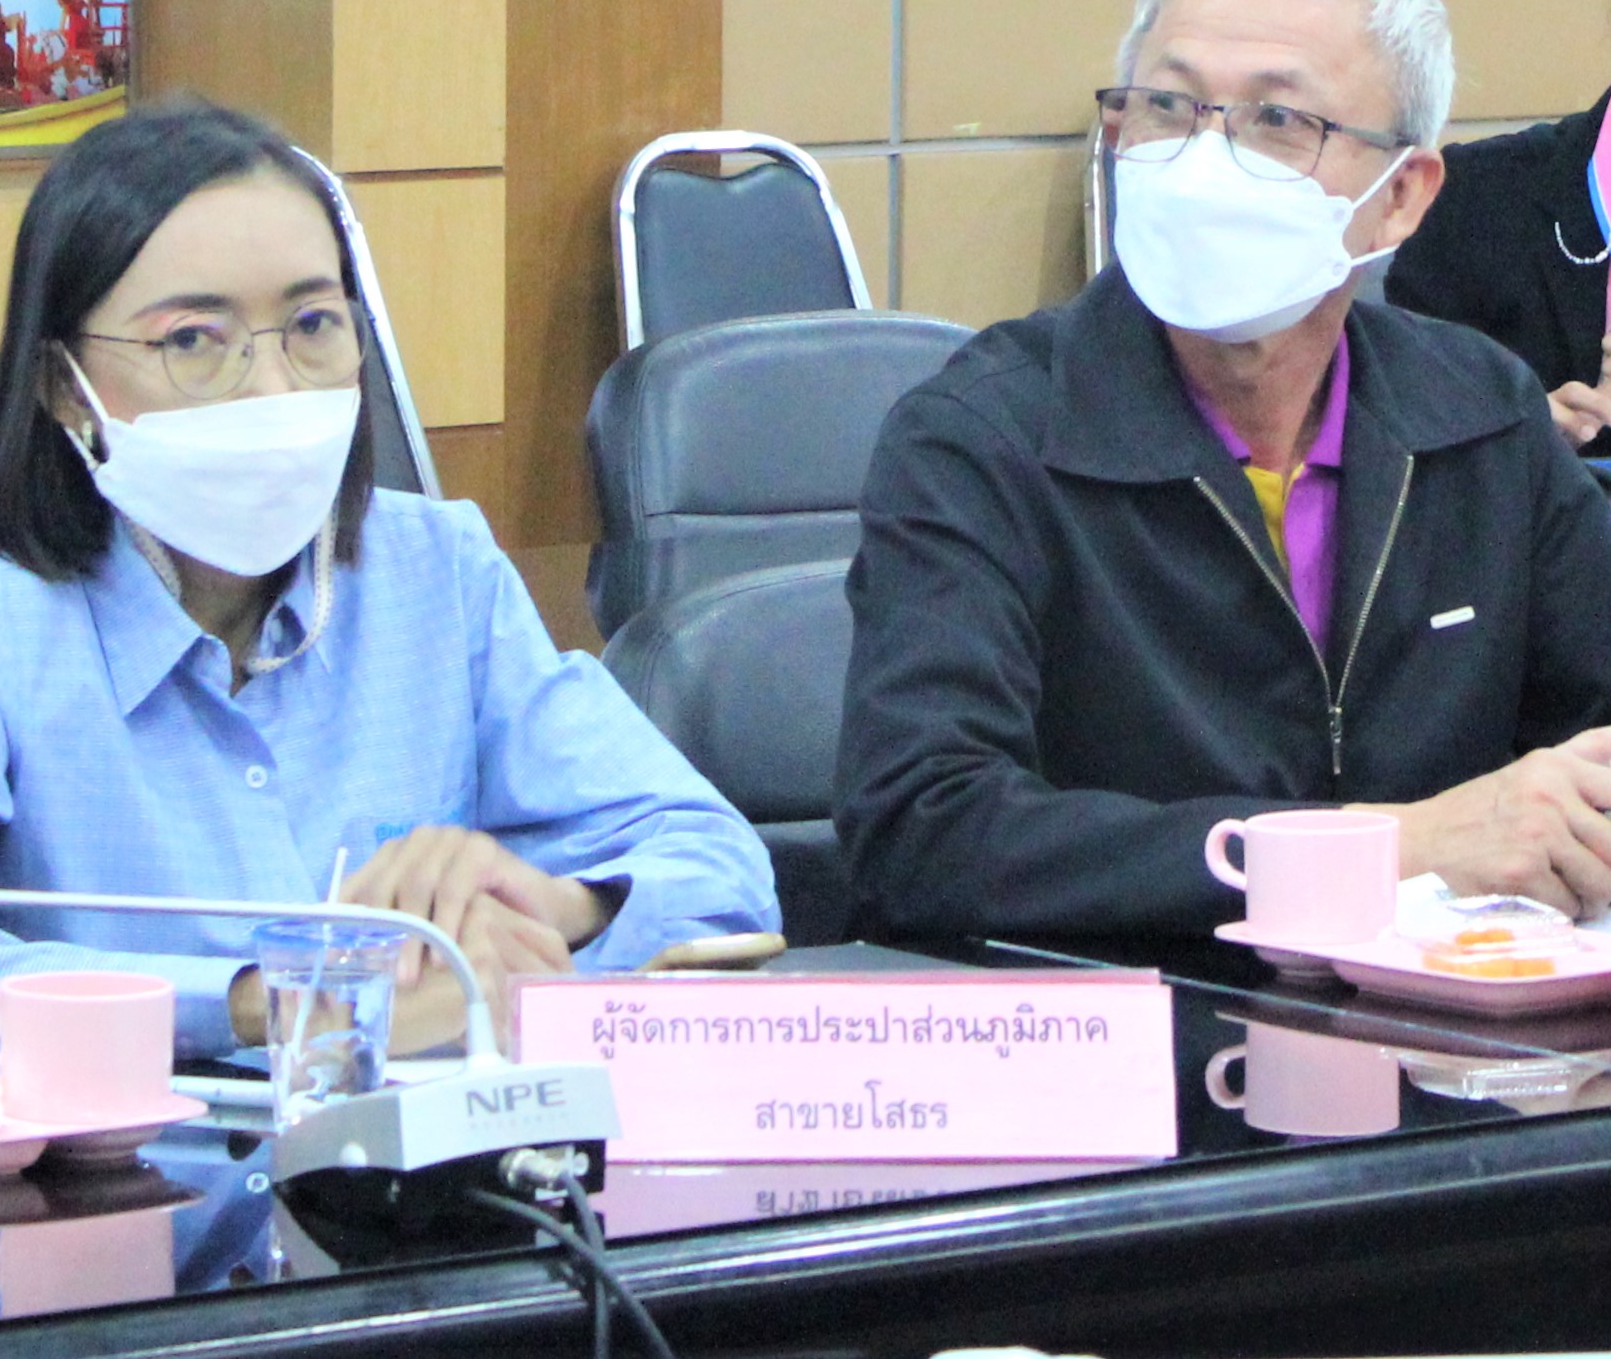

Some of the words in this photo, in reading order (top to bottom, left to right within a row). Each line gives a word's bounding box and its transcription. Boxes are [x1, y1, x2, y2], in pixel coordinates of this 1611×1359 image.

[592, 1000, 1109, 1060] ผู้จัดการการประปาส่วนภูมิภาค
[466, 1078, 568, 1117] NPE
[755, 1080, 949, 1130] สาขายโสธร
